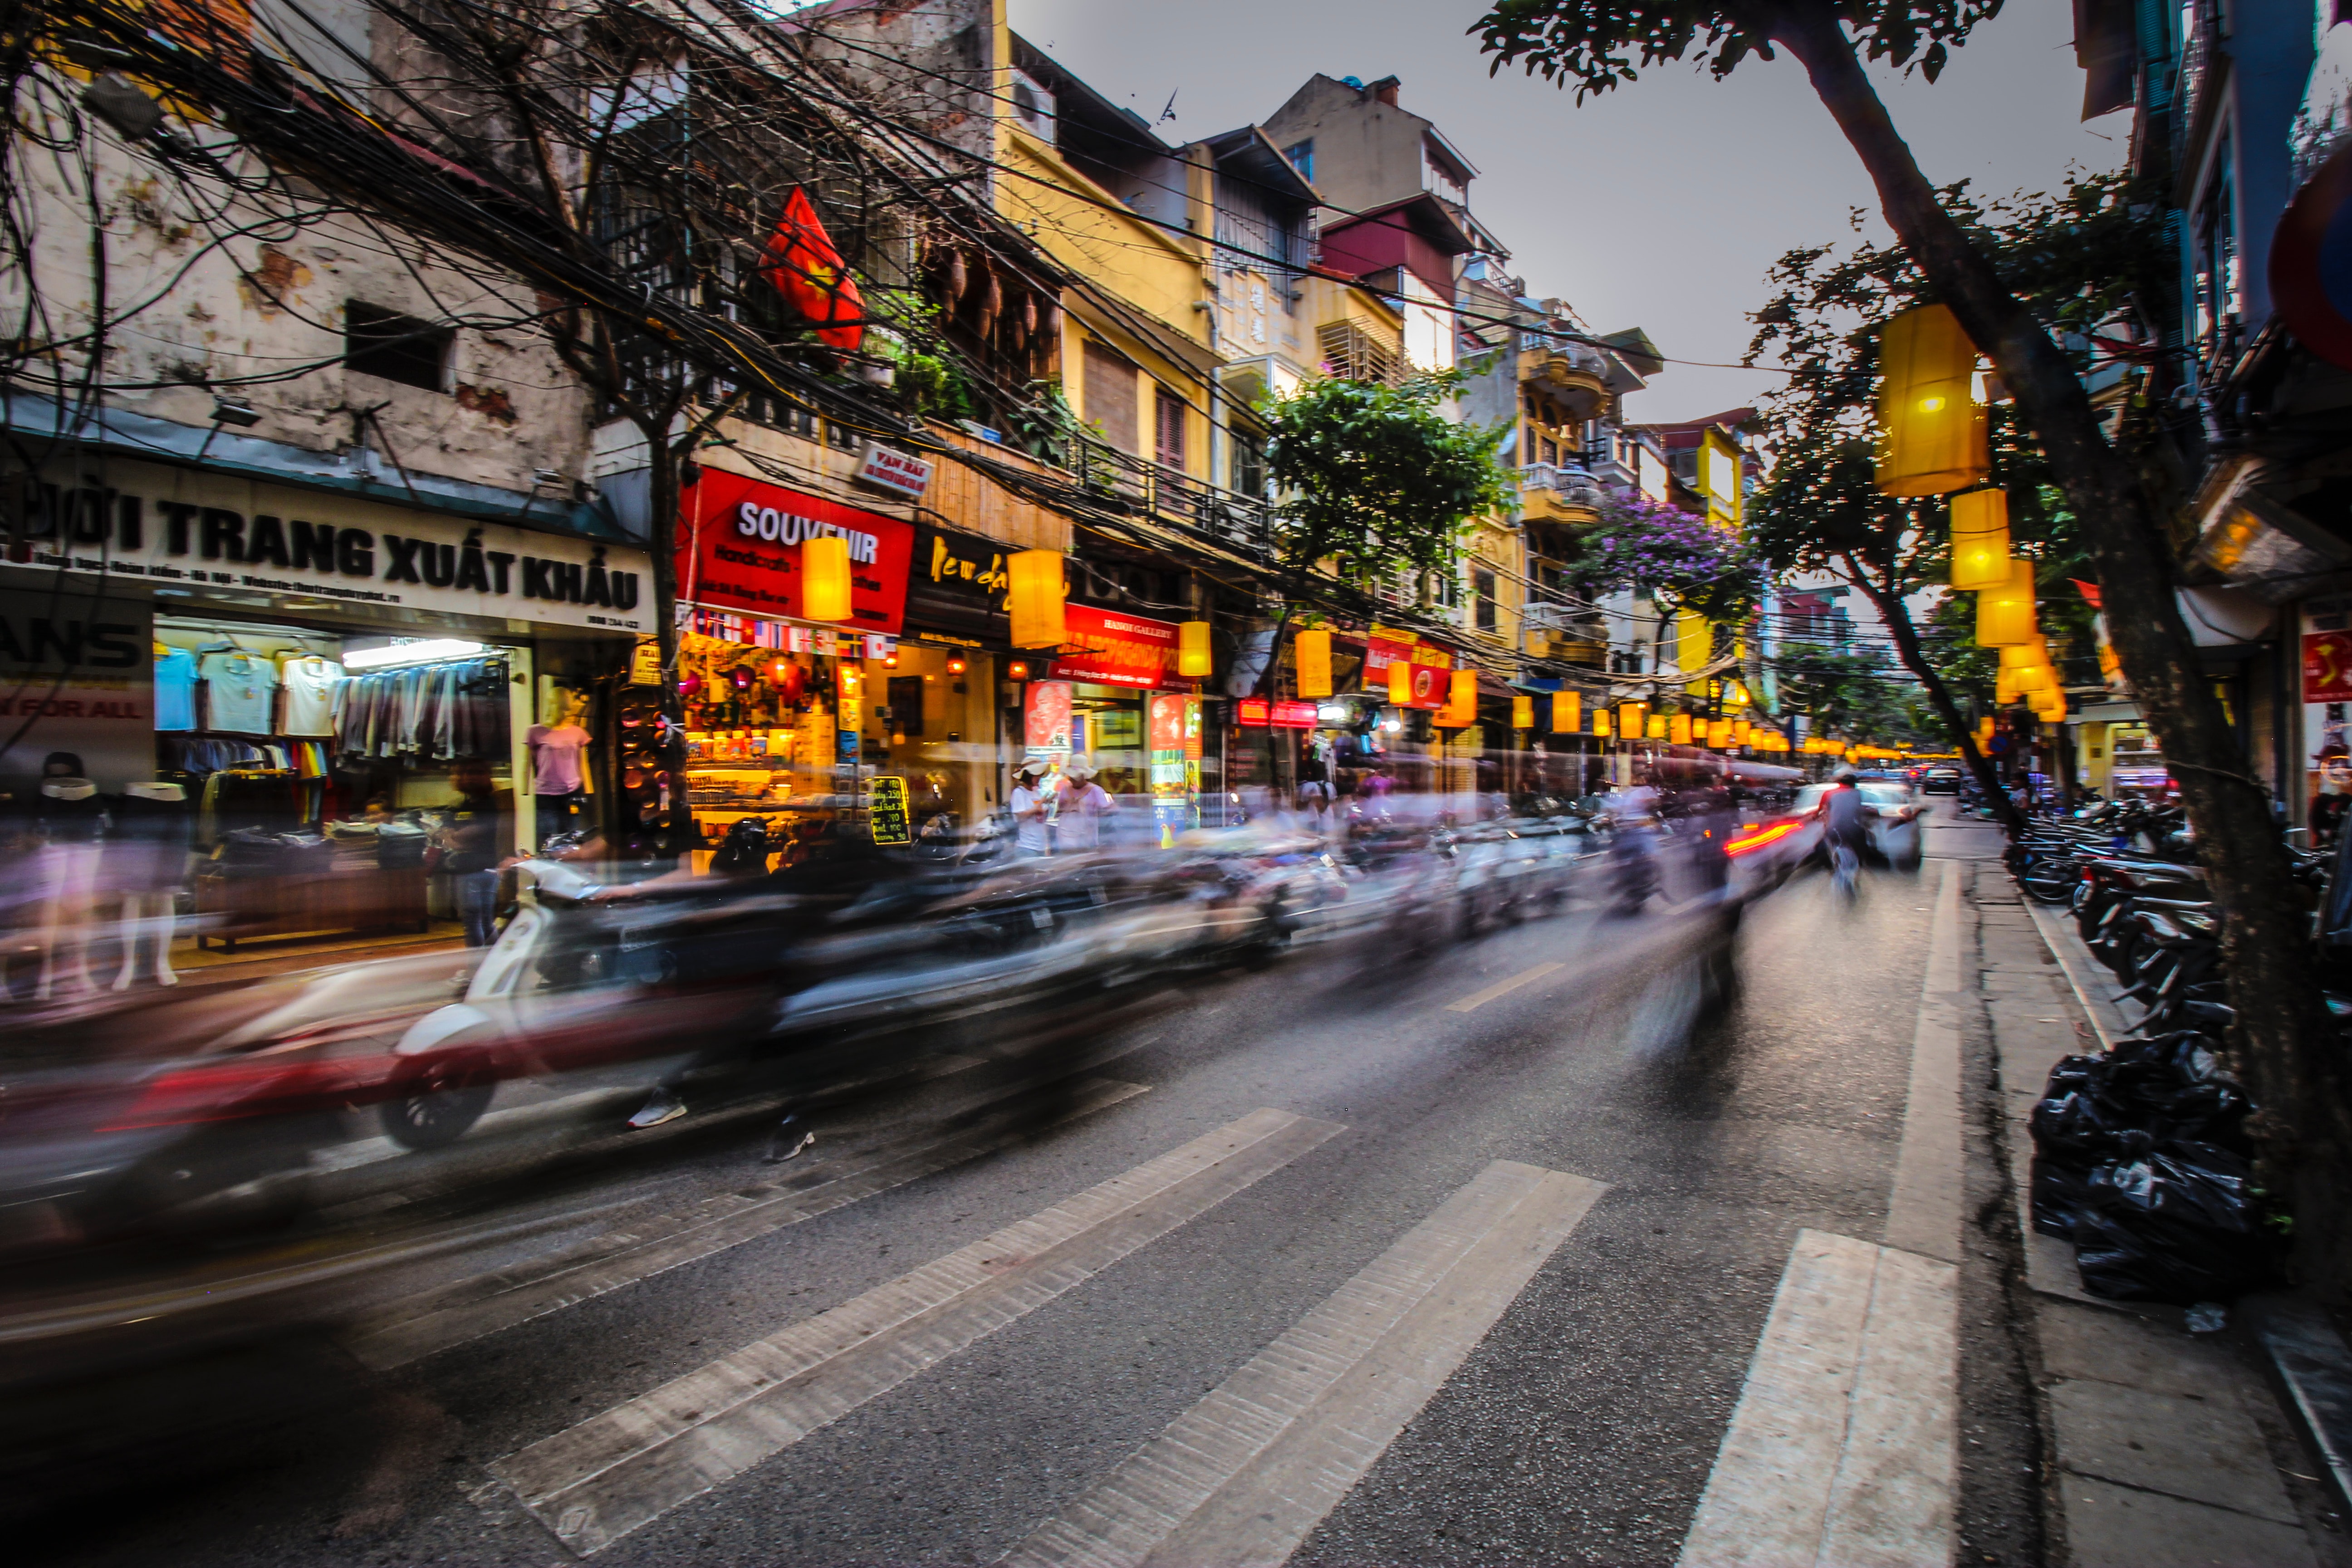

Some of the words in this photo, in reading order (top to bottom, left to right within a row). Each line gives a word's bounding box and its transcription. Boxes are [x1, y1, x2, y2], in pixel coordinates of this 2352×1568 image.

[157, 500, 373, 576] TRANG
[383, 528, 514, 593] XUẤT
[522, 546, 638, 610] KHẨU
[714, 544, 791, 573] Handicrafts
[1104, 619, 1133, 633] HANOI
[1134, 625, 1174, 639] GALLERY
[1083, 634, 1161, 671] PROPAGANDA
[20, 699, 84, 717] FOR
[88, 701, 144, 719] ALL
